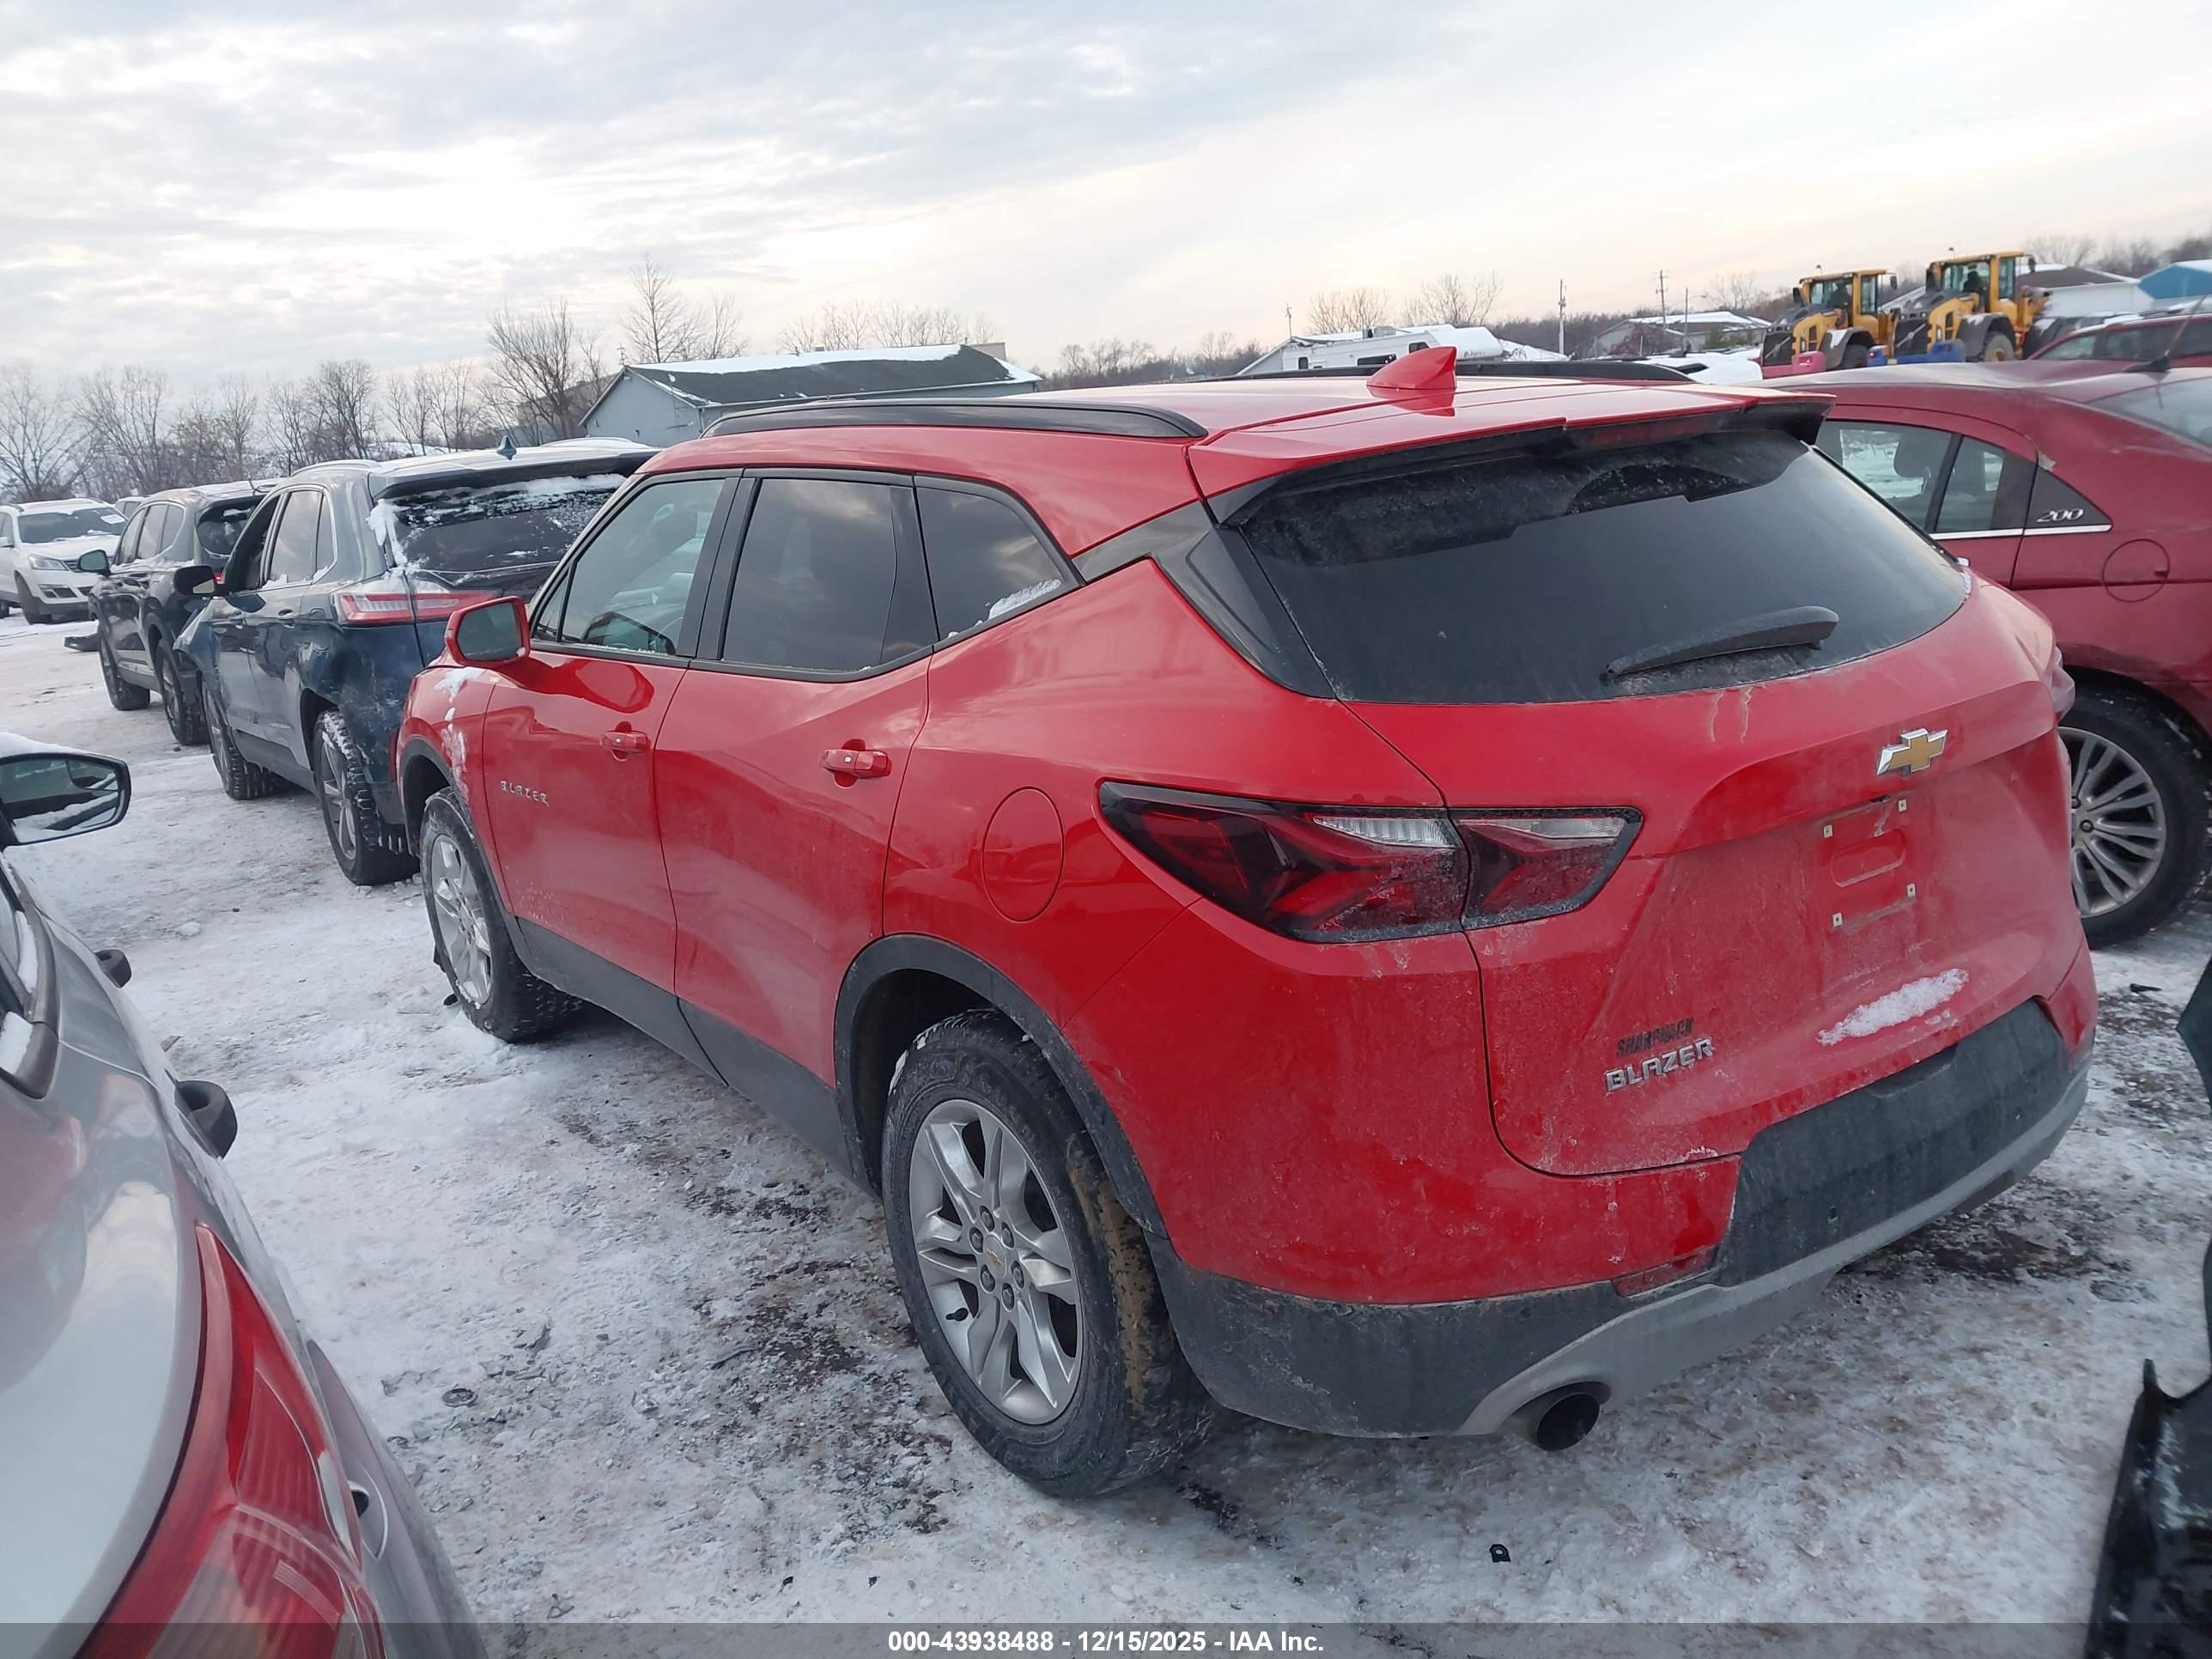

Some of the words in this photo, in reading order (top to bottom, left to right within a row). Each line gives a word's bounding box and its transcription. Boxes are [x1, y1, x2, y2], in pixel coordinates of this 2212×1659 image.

[2037, 508, 2084, 522] 200
[501, 780, 549, 805] BLAZER
[1605, 1037, 1713, 1091] BLAZER
